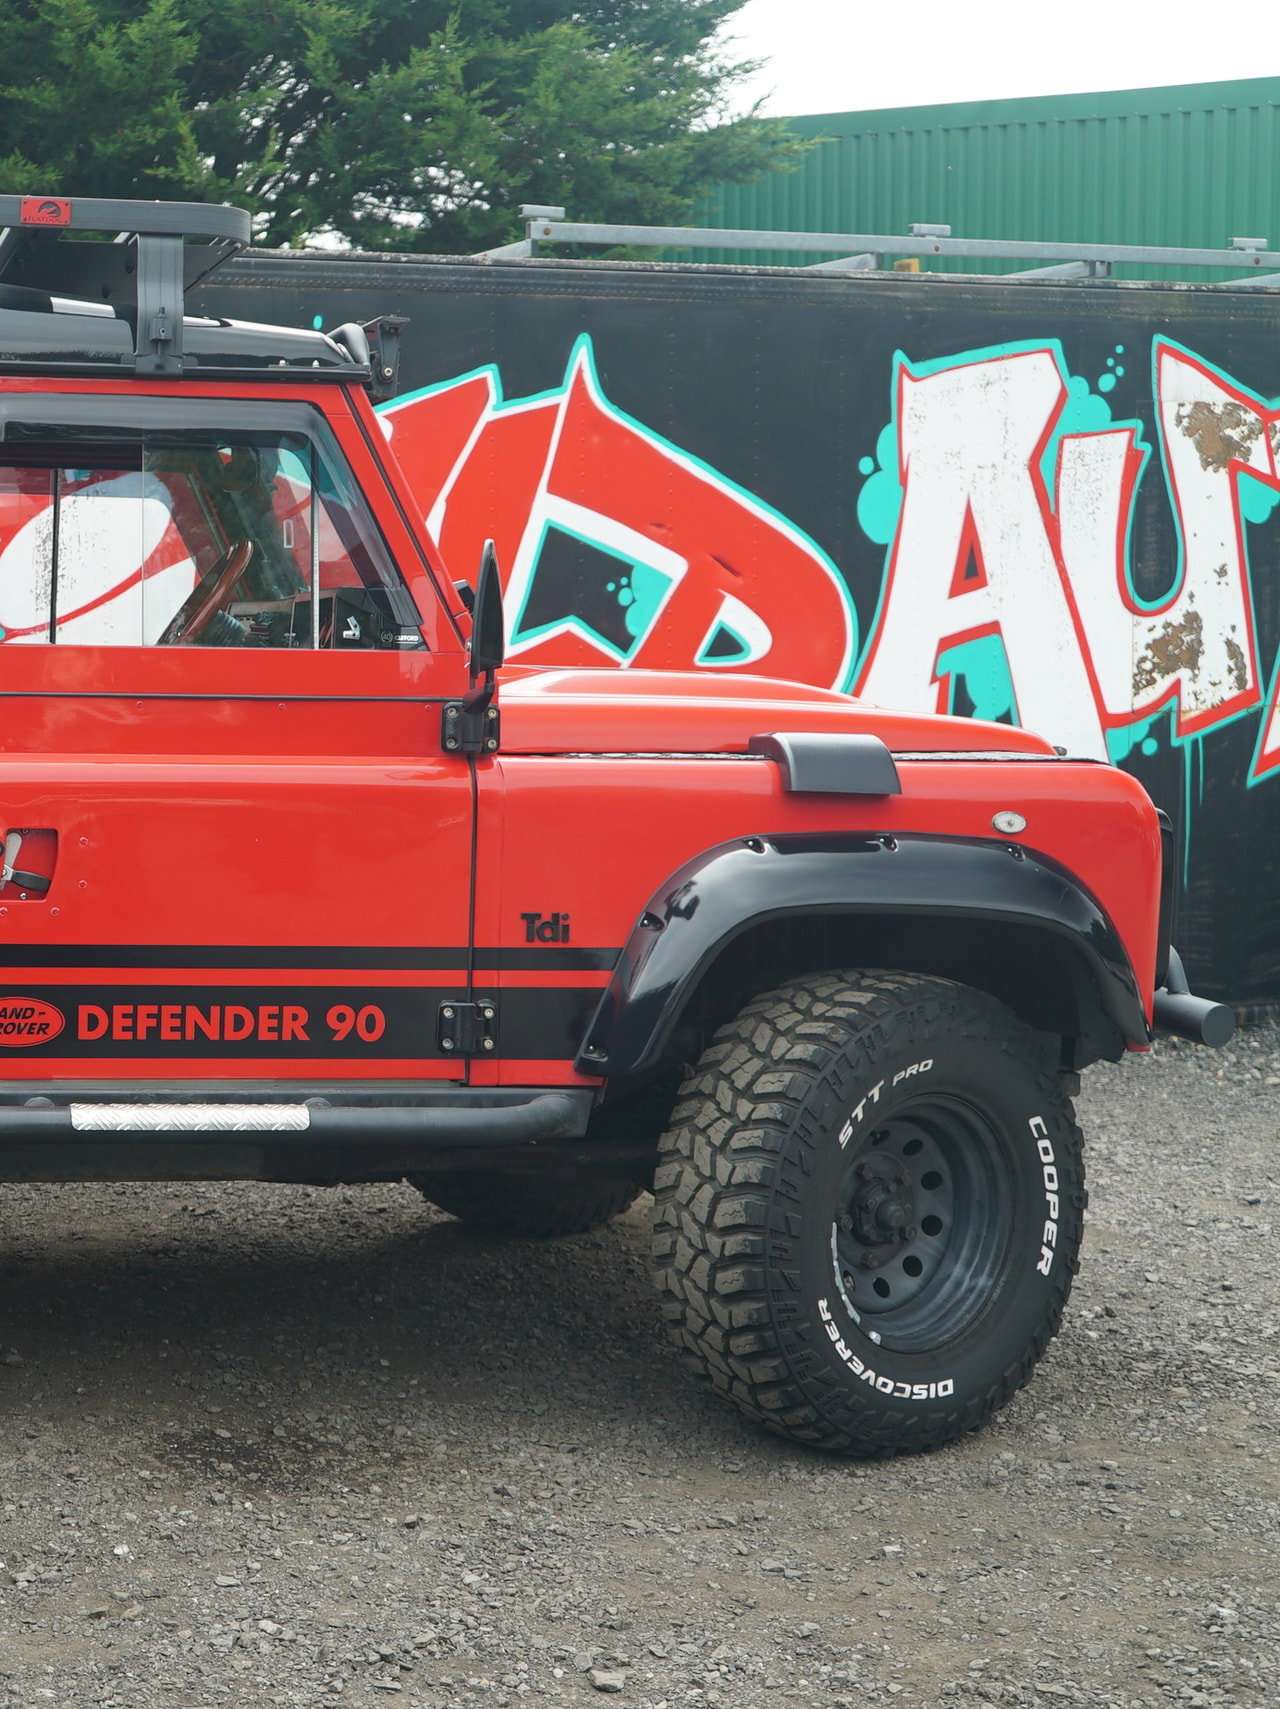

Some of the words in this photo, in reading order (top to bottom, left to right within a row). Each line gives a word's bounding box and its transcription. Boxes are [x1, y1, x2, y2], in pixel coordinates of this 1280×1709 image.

[521, 912, 570, 943] Tdi
[77, 1004, 310, 1041] DEFENDER
[326, 1004, 386, 1042] 90
[838, 1079, 885, 1150] STT
[892, 1058, 934, 1087] PRO
[1028, 1115, 1060, 1277] COOPER
[817, 1297, 954, 1400] DISCOVERER
